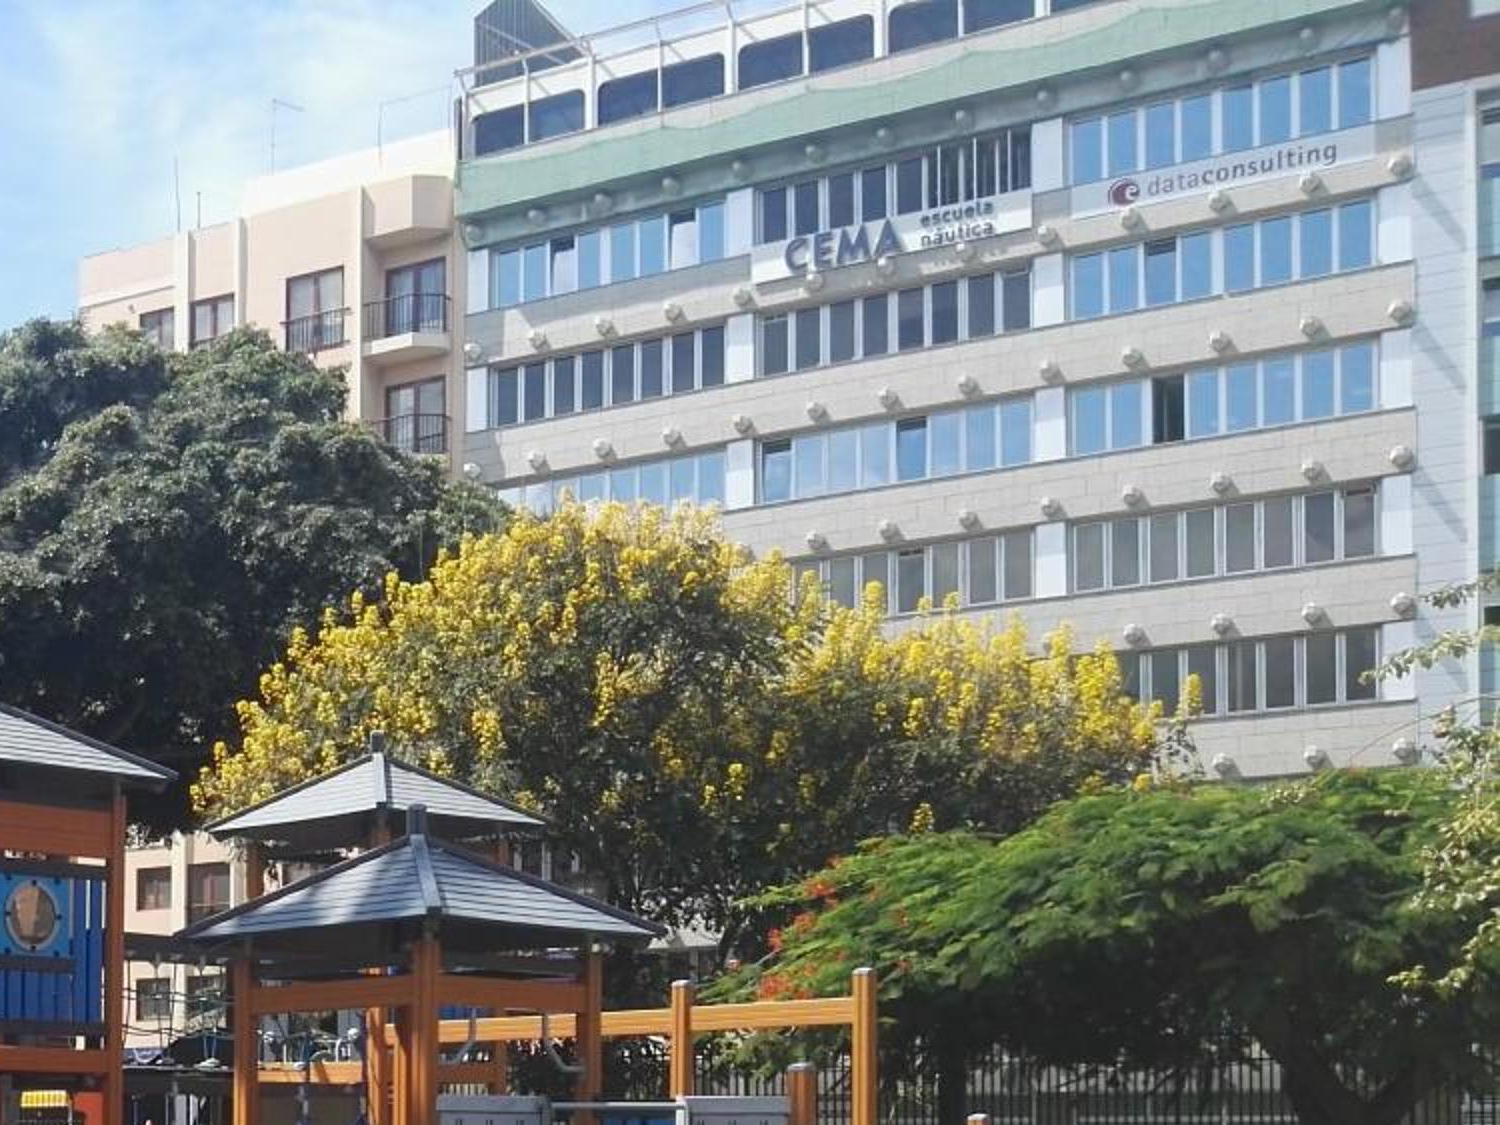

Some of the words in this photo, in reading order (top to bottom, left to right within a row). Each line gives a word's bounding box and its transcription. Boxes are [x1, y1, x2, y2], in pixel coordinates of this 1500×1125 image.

[1147, 143, 1338, 196] dataconsulting
[920, 200, 994, 228] escuela
[784, 216, 902, 273] CEMA
